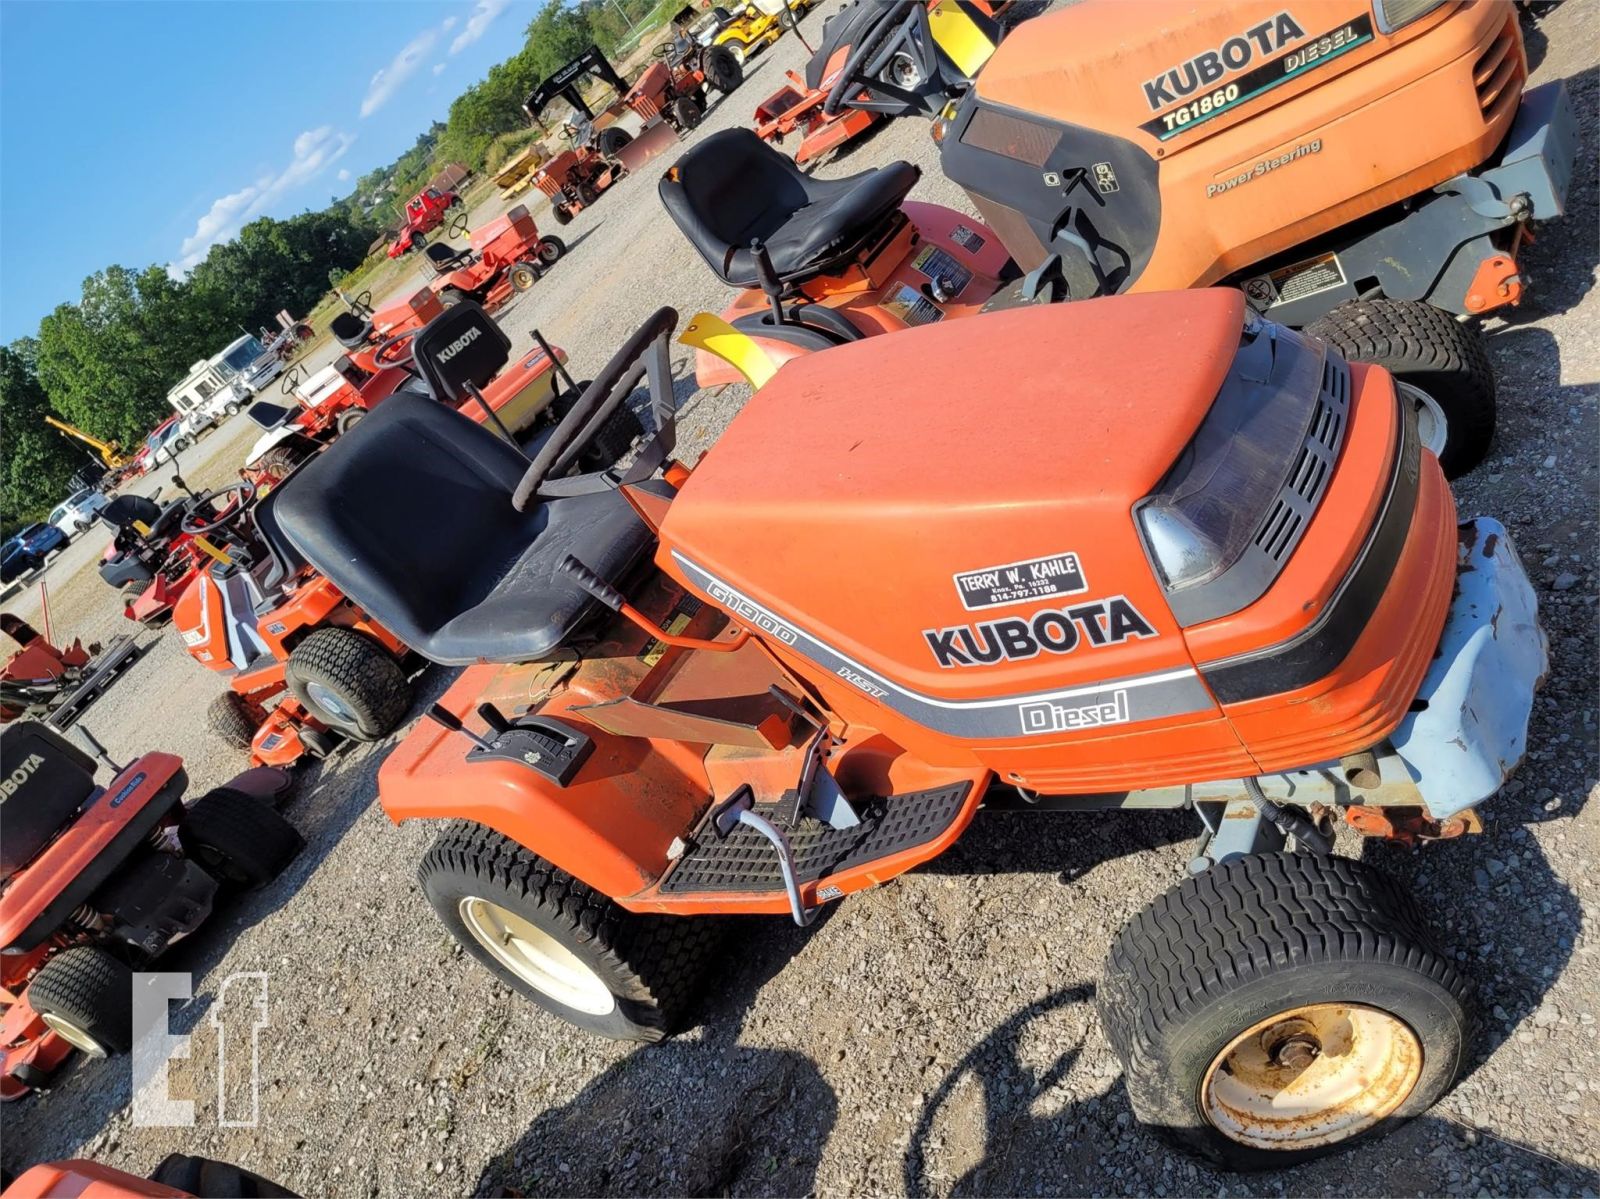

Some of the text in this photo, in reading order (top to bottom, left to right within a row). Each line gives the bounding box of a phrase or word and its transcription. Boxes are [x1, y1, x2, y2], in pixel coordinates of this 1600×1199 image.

[1142, 11, 1307, 110] KUBOTA
[1283, 26, 1358, 73] DIESEL
[1163, 84, 1240, 131] TG1860
[1206, 138, 1322, 198] Power Steering
[436, 326, 482, 364] KUBOTA
[960, 557, 1076, 592] TERRY W. KAHLE
[990, 584, 1058, 602] 814-797-1188
[1014, 582, 1026, 590] Pa.
[1028, 578, 1050, 588] 16232
[707, 582, 797, 646] G1900
[923, 596, 1158, 668] KUBOTA
[836, 666, 890, 698] HST
[1018, 689, 1130, 735] Diesel
